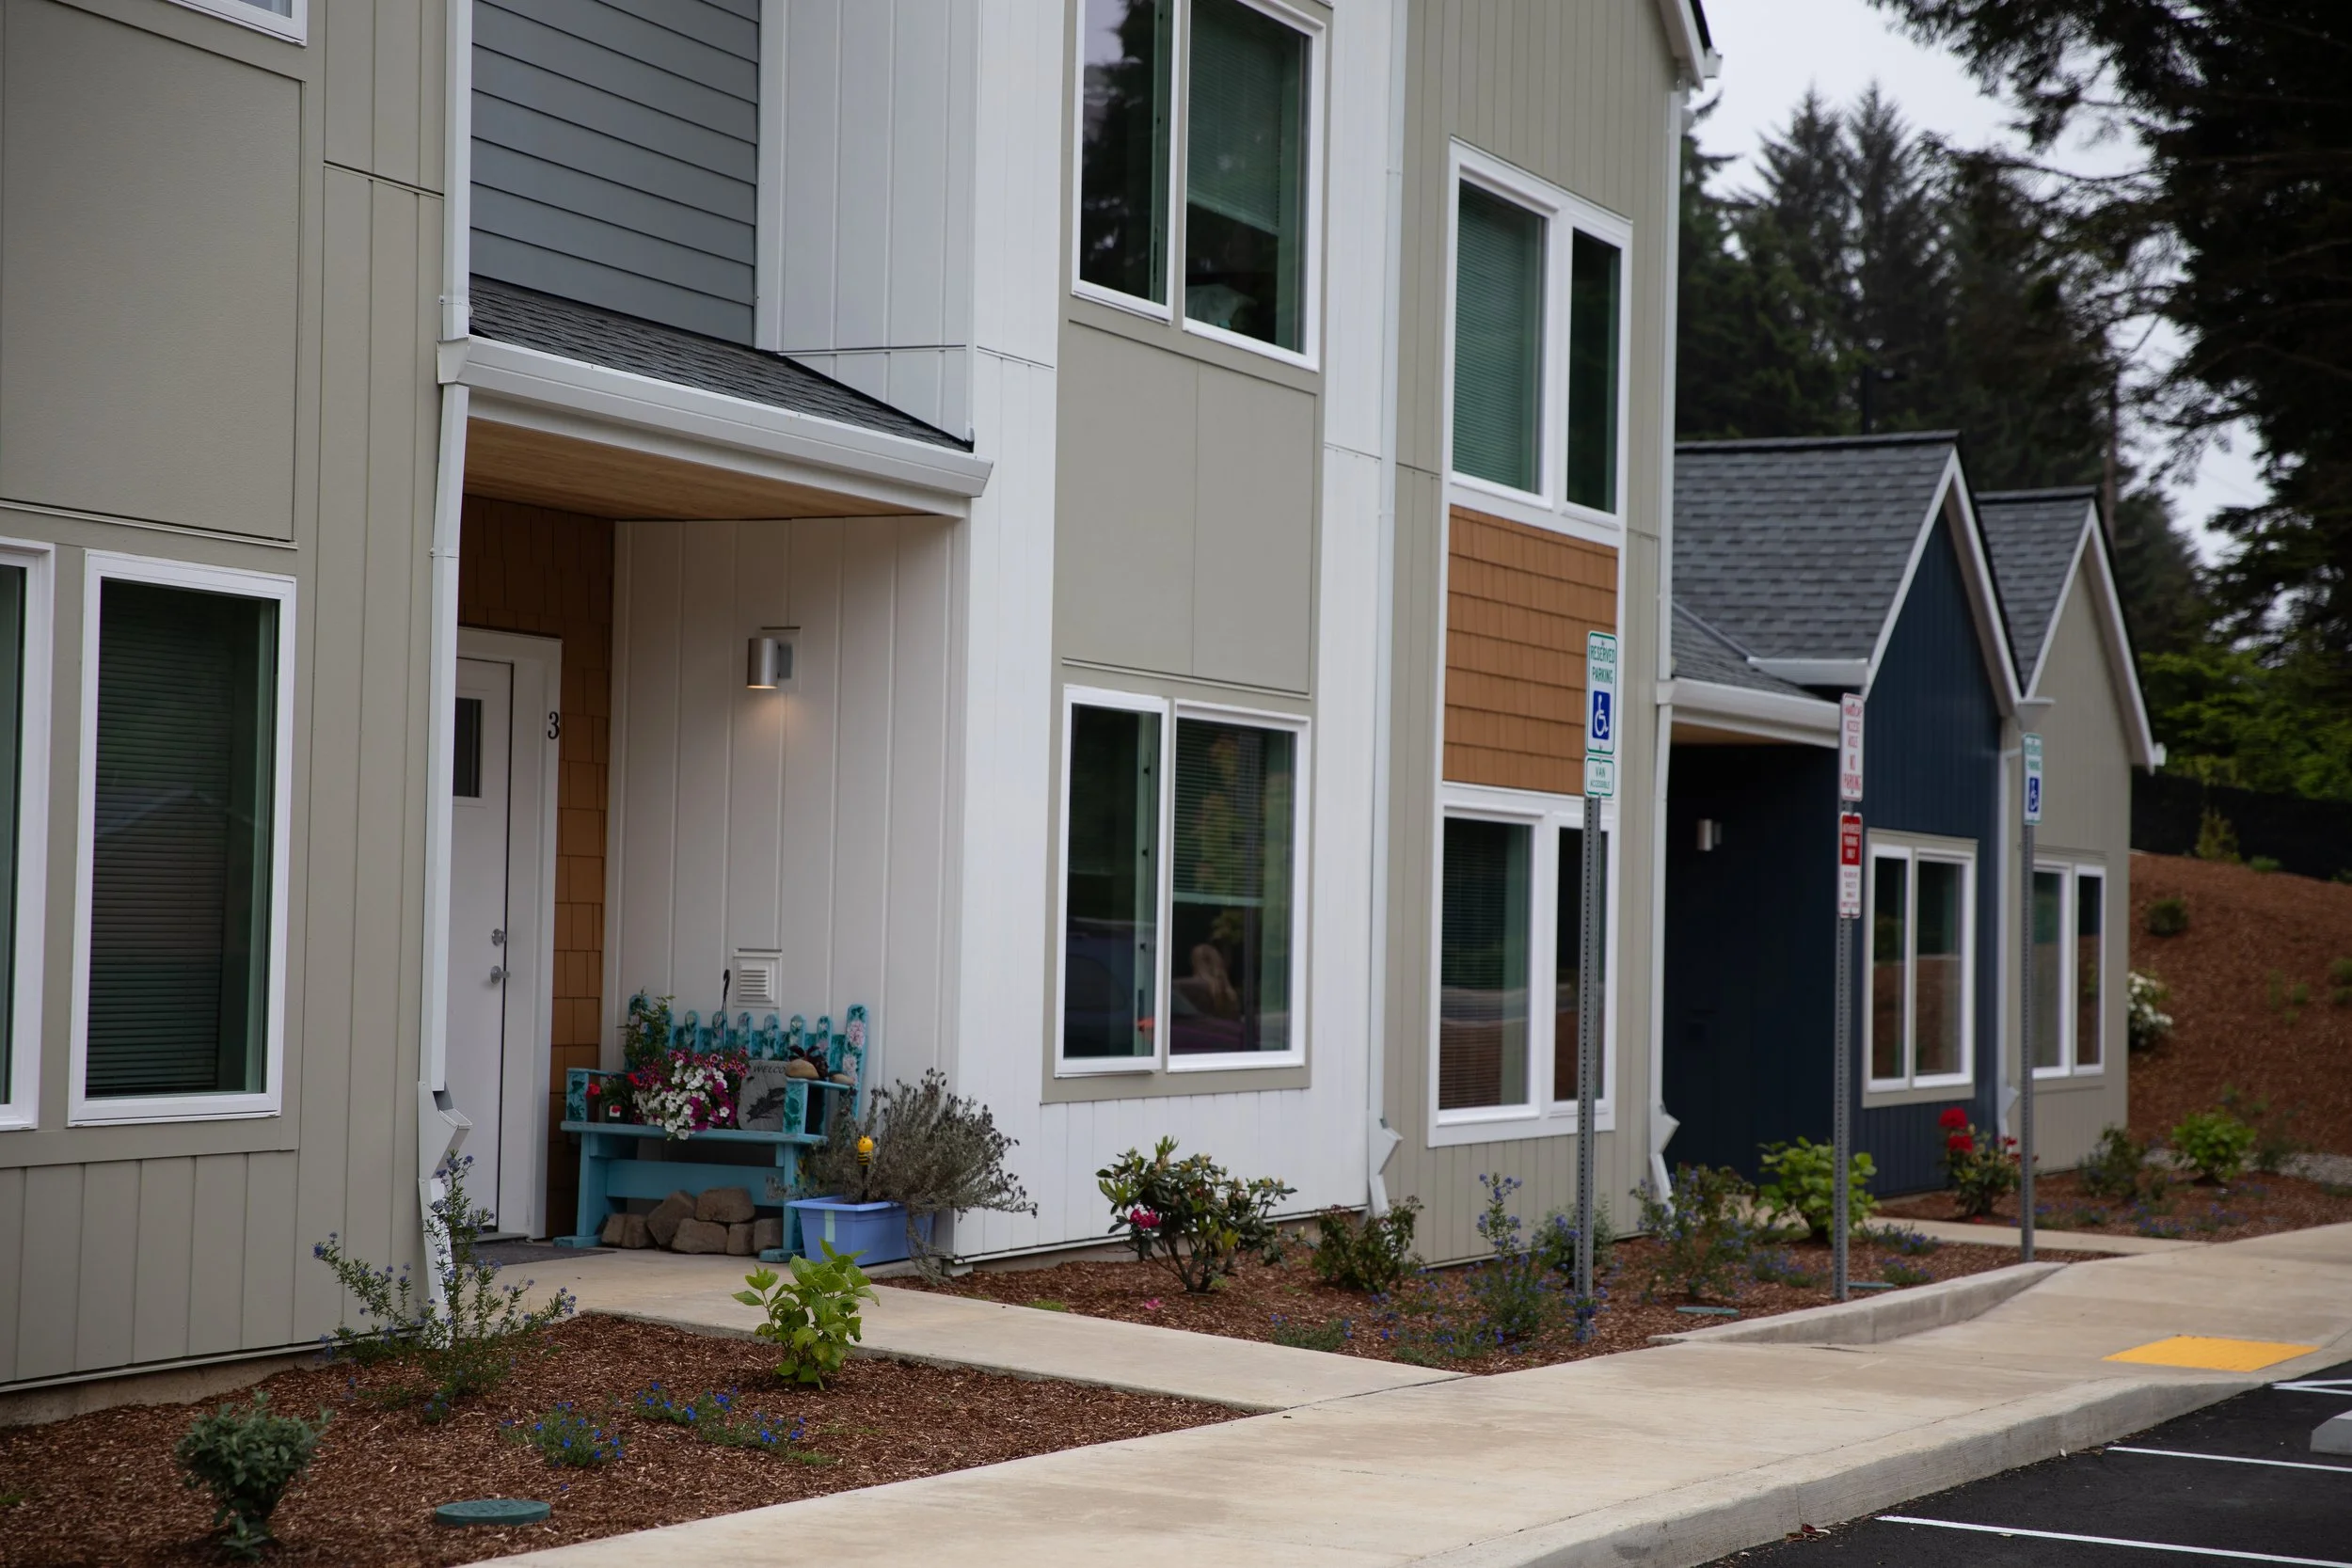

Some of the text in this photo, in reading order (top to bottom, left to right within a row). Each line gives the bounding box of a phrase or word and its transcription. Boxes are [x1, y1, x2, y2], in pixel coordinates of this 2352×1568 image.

[1591, 645, 1615, 664] RESERVED
[1592, 666, 1613, 685] PARKING
[548, 711, 560, 739] 3
[1595, 766, 1606, 779] VAN
